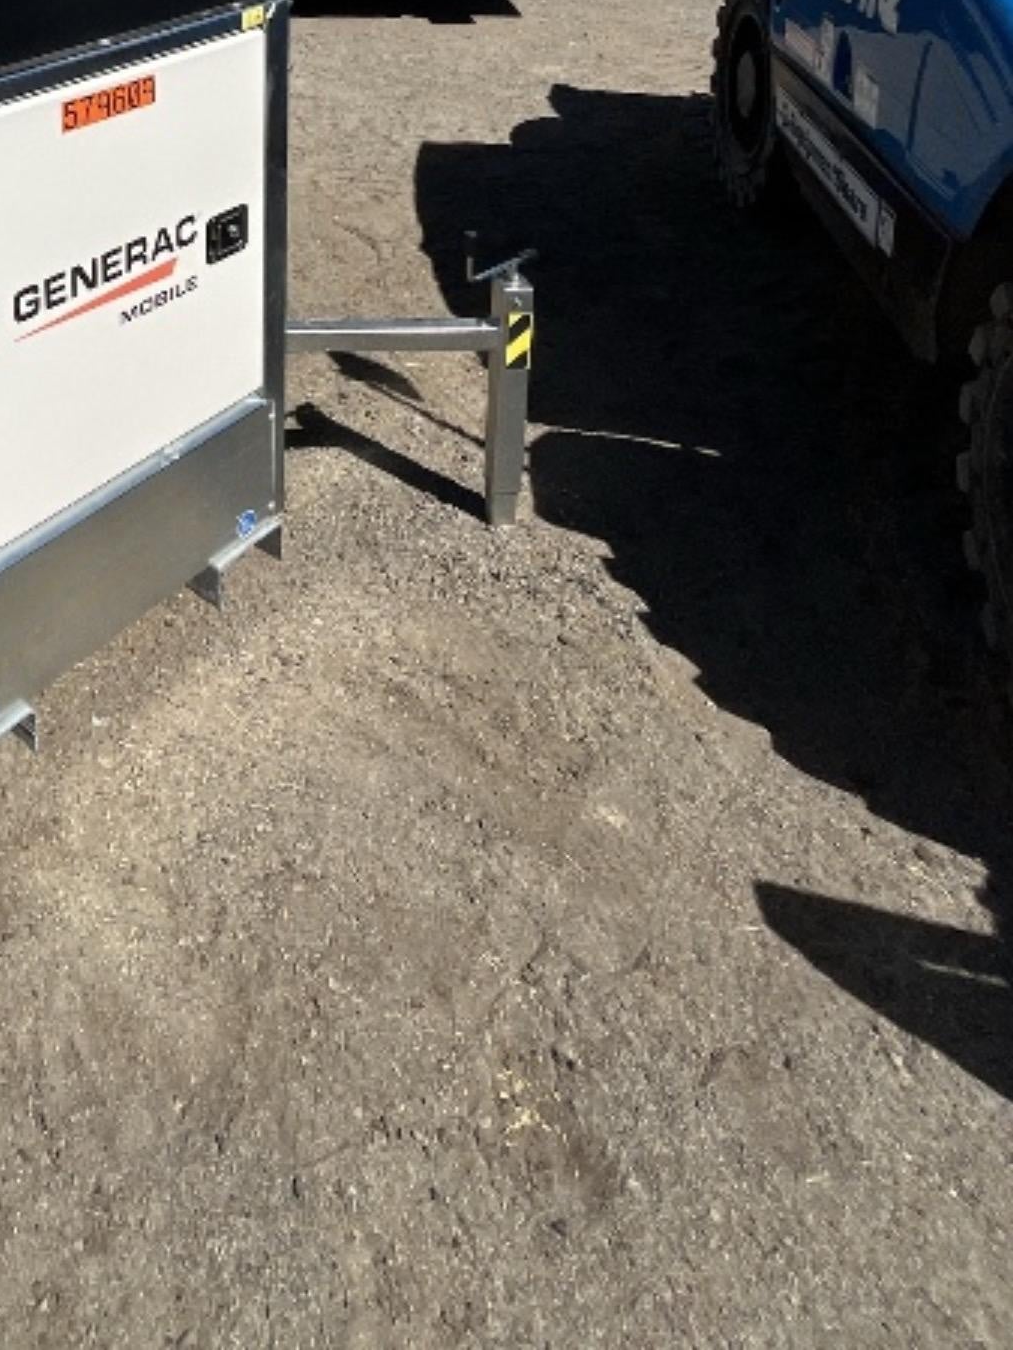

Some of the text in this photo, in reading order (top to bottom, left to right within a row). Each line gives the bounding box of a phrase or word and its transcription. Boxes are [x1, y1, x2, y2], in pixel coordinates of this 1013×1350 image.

[64, 76, 156, 130] 579609
[13, 214, 198, 323] GENERAC
[119, 275, 198, 327] MOBILE
